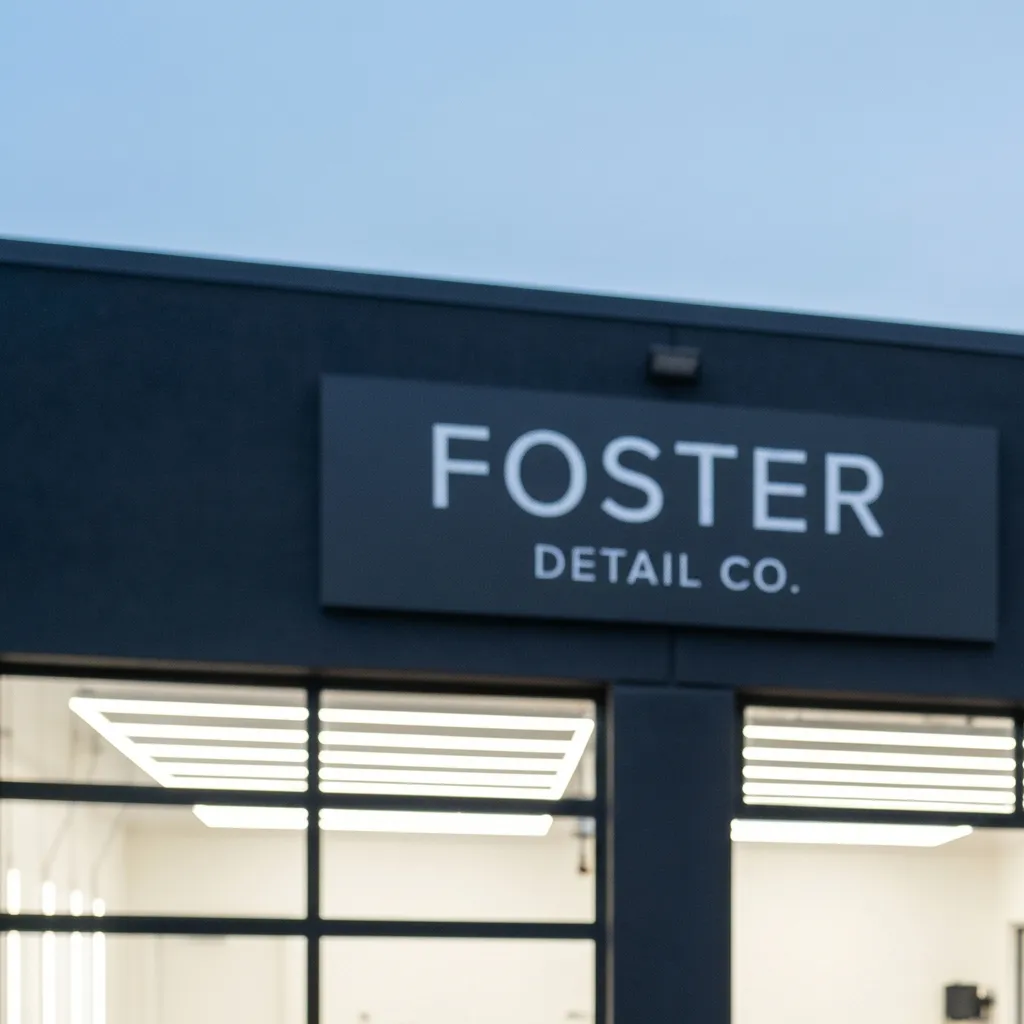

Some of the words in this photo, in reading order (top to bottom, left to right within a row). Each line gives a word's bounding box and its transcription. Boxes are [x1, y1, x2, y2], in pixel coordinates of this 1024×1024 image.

[432, 423, 884, 537] FOSTER
[535, 544, 701, 588] DETAIL
[719, 556, 800, 594] CO.
